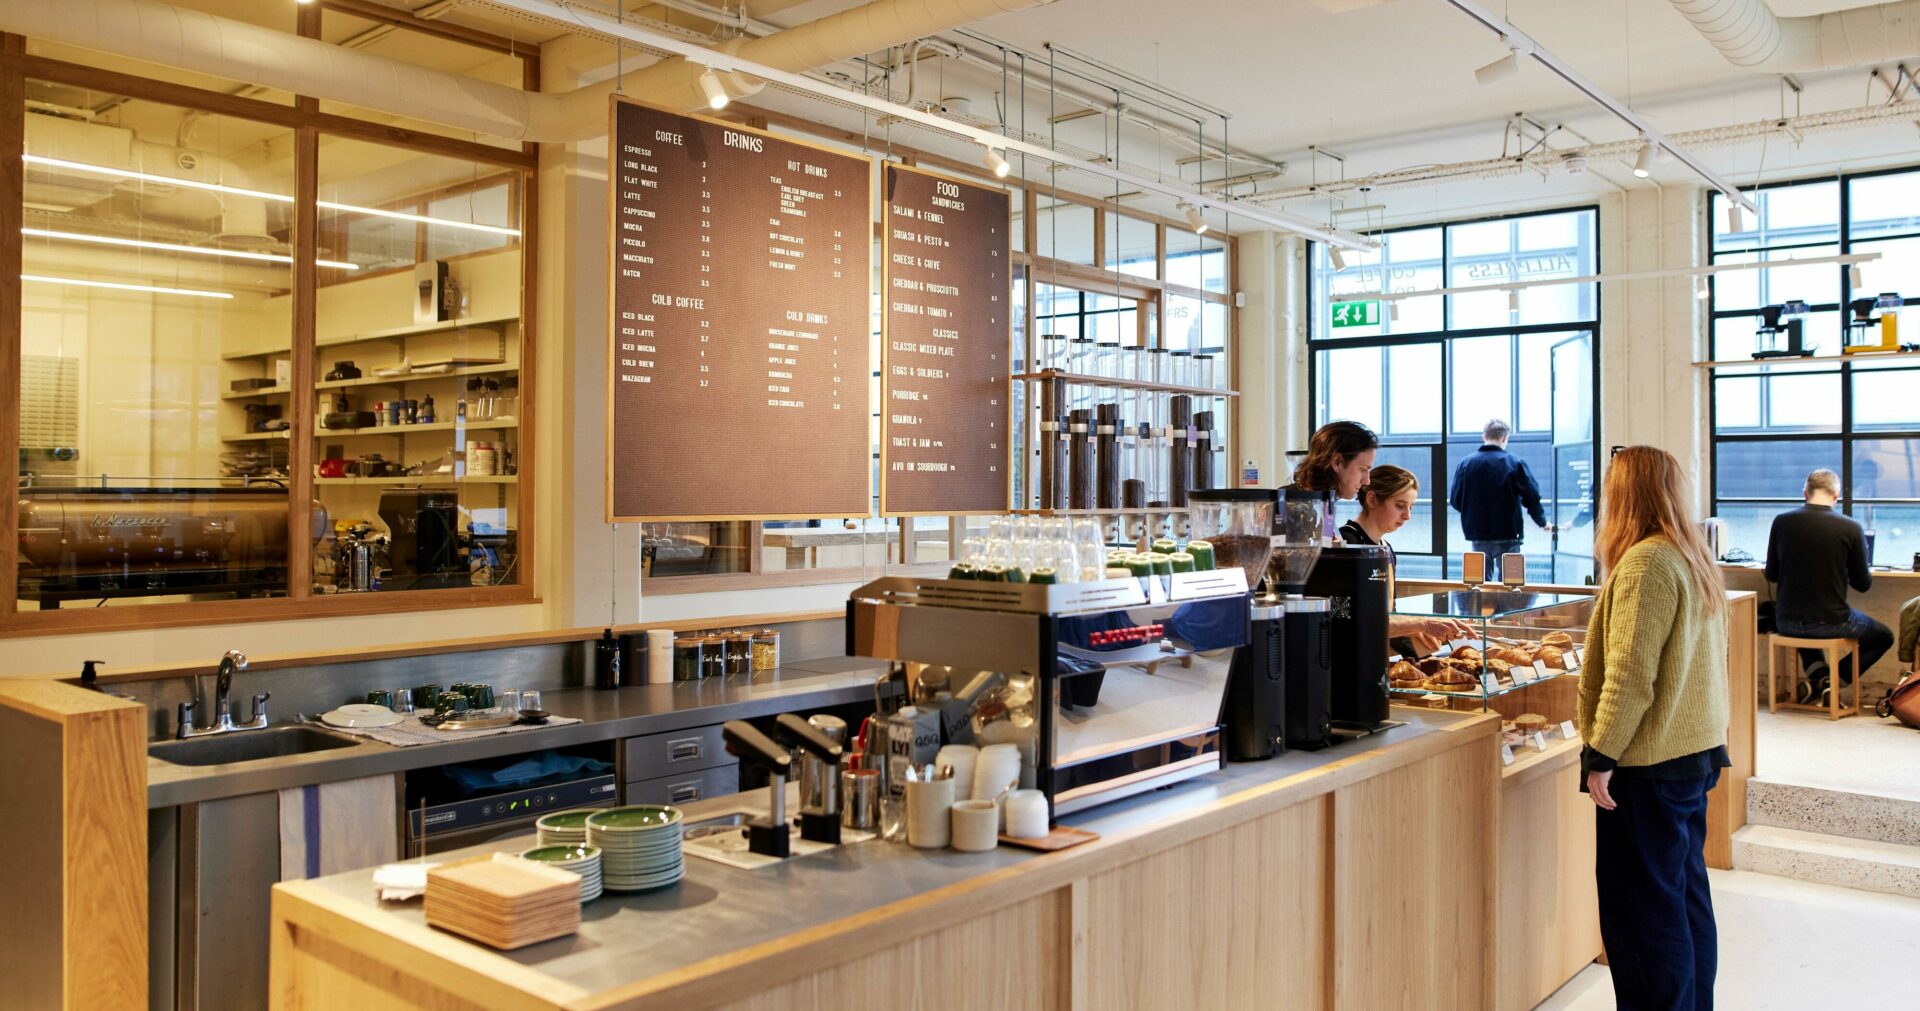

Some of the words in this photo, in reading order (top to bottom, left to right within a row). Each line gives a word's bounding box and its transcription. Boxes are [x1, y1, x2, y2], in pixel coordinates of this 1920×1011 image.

[656, 130, 683, 146] COFFEE
[724, 131, 763, 152] DRINKS
[624, 145, 652, 157] ESPRESSO
[624, 161, 639, 170] LONG
[641, 163, 658, 173] BLACK
[787, 161, 800, 172] HOT
[805, 164, 828, 178] DRINKS
[624, 176, 638, 185] FLAT
[641, 179, 658, 189] WHITE
[770, 176, 782, 184] TEAS
[702, 191, 710, 199] 3.5
[781, 186, 800, 196] ENGLISH
[800, 188, 824, 200] BREAKFAST
[937, 181, 959, 198] FOOD
[624, 192, 641, 201] LATTE
[781, 193, 792, 201] EARL
[793, 195, 804, 203] GREY
[780, 200, 795, 208] GREEN
[932, 196, 965, 211] SANDWICHES
[624, 207, 656, 219] CAPPUCCINO
[780, 207, 807, 217] CHAMOMILE
[893, 205, 914, 218] SALAMI
[918, 210, 921, 219] &
[924, 212, 944, 224] FENNEL
[624, 223, 643, 232] MOCHA
[769, 218, 780, 226] CHAI
[623, 238, 646, 248] PICCOLO
[779, 234, 804, 244] CHOCOLATE
[893, 229, 914, 242] SQUASH
[918, 234, 921, 243] &
[924, 235, 942, 247] PESTO
[769, 246, 785, 255] LEMON
[790, 250, 804, 258] HONEY
[623, 253, 654, 264] MACCHIATO
[893, 253, 914, 266] CHEESE
[918, 258, 921, 267] &
[924, 258, 940, 270] CHIVE
[769, 260, 784, 269] FRESH
[784, 263, 796, 271] MINT
[623, 269, 640, 278] BATCH
[893, 278, 918, 290] CHEDDAR
[920, 281, 924, 291] &
[926, 282, 958, 296] PROSCIUTTO
[652, 294, 672, 306] COLD
[676, 296, 704, 310] COFFEE
[893, 302, 918, 314] CHEDDAR
[920, 306, 924, 315] &
[926, 306, 947, 318] TOMATO
[622, 312, 635, 320] ICED
[637, 313, 655, 322] BLACK
[786, 310, 803, 322] COLD
[806, 313, 828, 324] DRINKS
[622, 327, 635, 336] ICED
[637, 329, 655, 337] LATTE
[933, 328, 958, 340] CLASSICS
[622, 343, 635, 351] ICED
[637, 344, 656, 353] MOCHA
[893, 341, 916, 353] CLASSIC
[920, 344, 937, 355] MIXED
[938, 346, 954, 356] PLATE
[622, 359, 636, 367] COLD
[639, 360, 655, 368] BREW
[768, 356, 783, 364] APPLE
[892, 365, 908, 376] EGGS
[910, 367, 914, 376] &
[916, 367, 944, 378] SOLDIERS
[892, 389, 920, 400] PORRIDGE
[779, 400, 804, 408] CHOCOLATE
[892, 414, 917, 425] GRANOLA
[893, 437, 910, 447] TOAST
[912, 438, 917, 447] &
[919, 438, 930, 447] JAM
[892, 462, 904, 471] AVO
[906, 462, 914, 471] ON
[916, 463, 948, 472] SOURDOUGH
